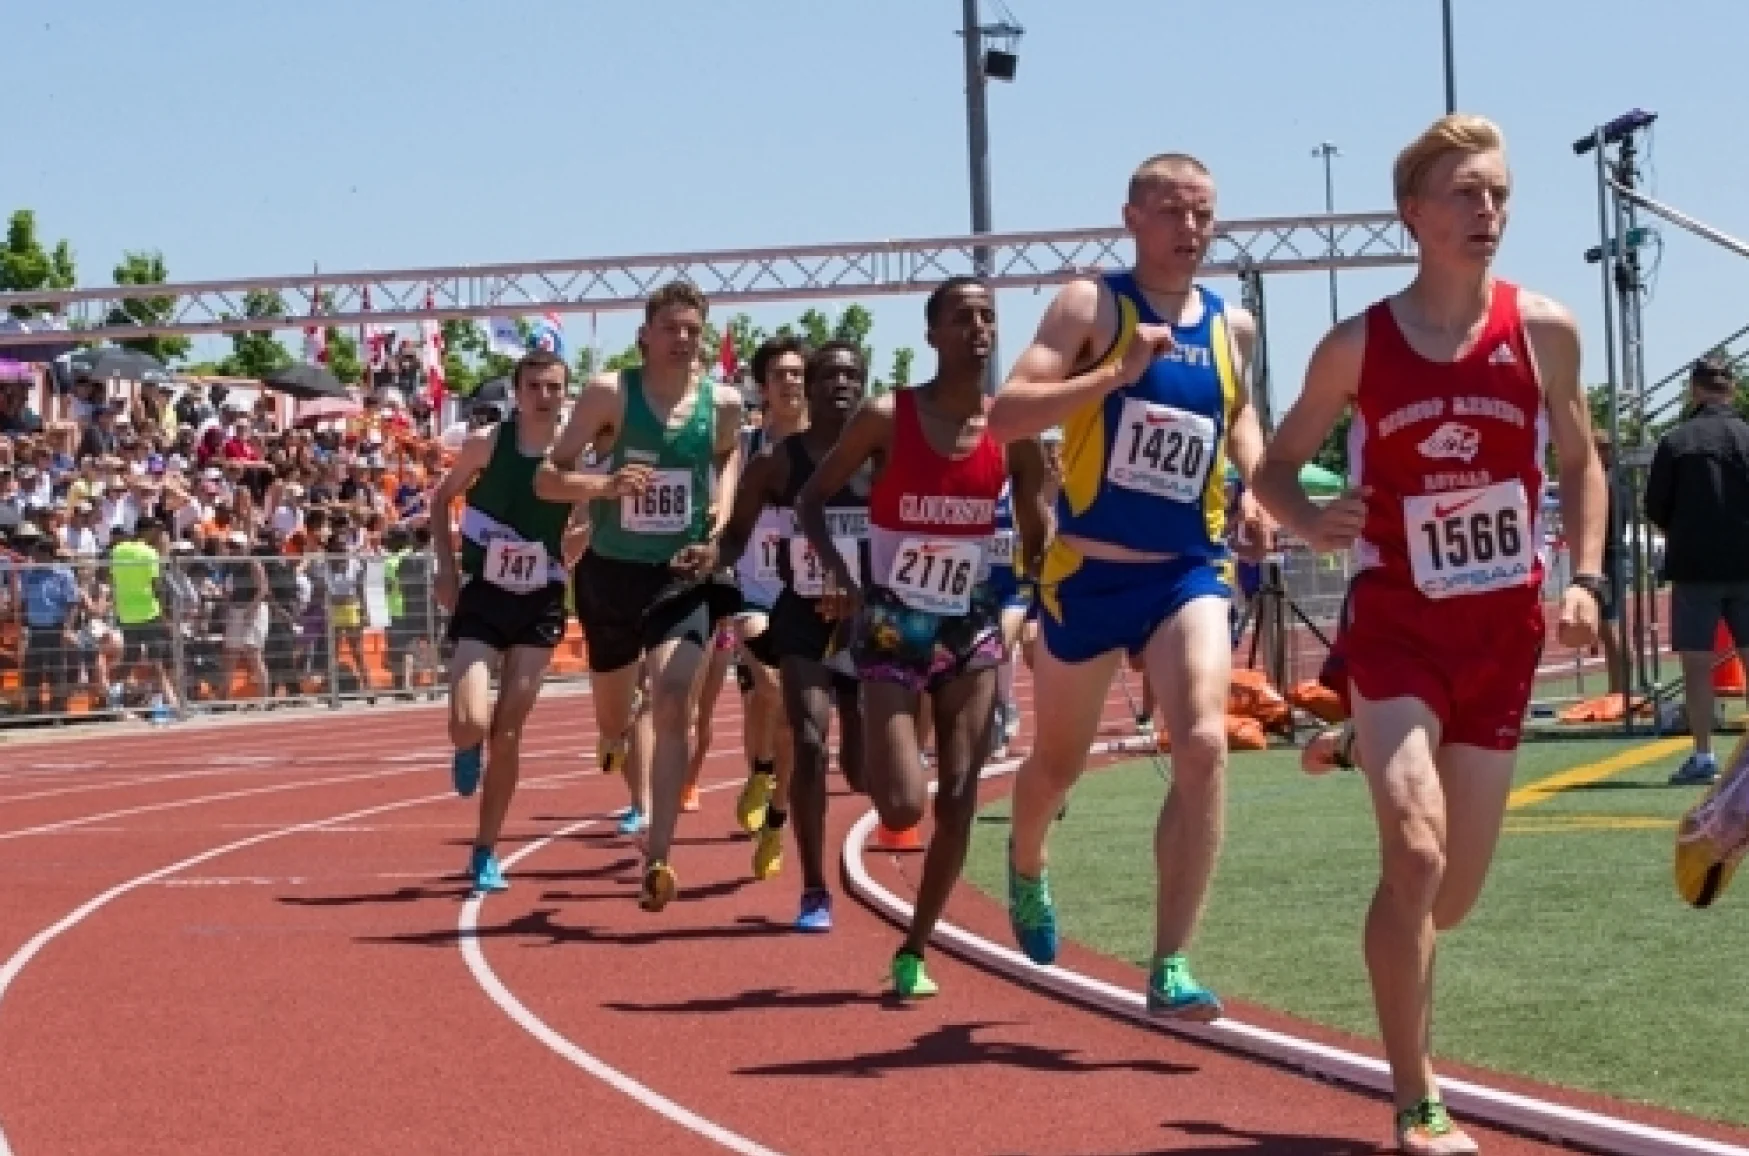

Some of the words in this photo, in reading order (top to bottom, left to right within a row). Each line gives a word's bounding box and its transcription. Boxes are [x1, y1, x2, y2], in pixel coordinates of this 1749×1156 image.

[1127, 421, 1205, 479] 1420
[634, 484, 687, 518] 1668
[1421, 506, 1522, 572] 1566
[498, 554, 537, 582] 747
[895, 550, 972, 597] 2116
